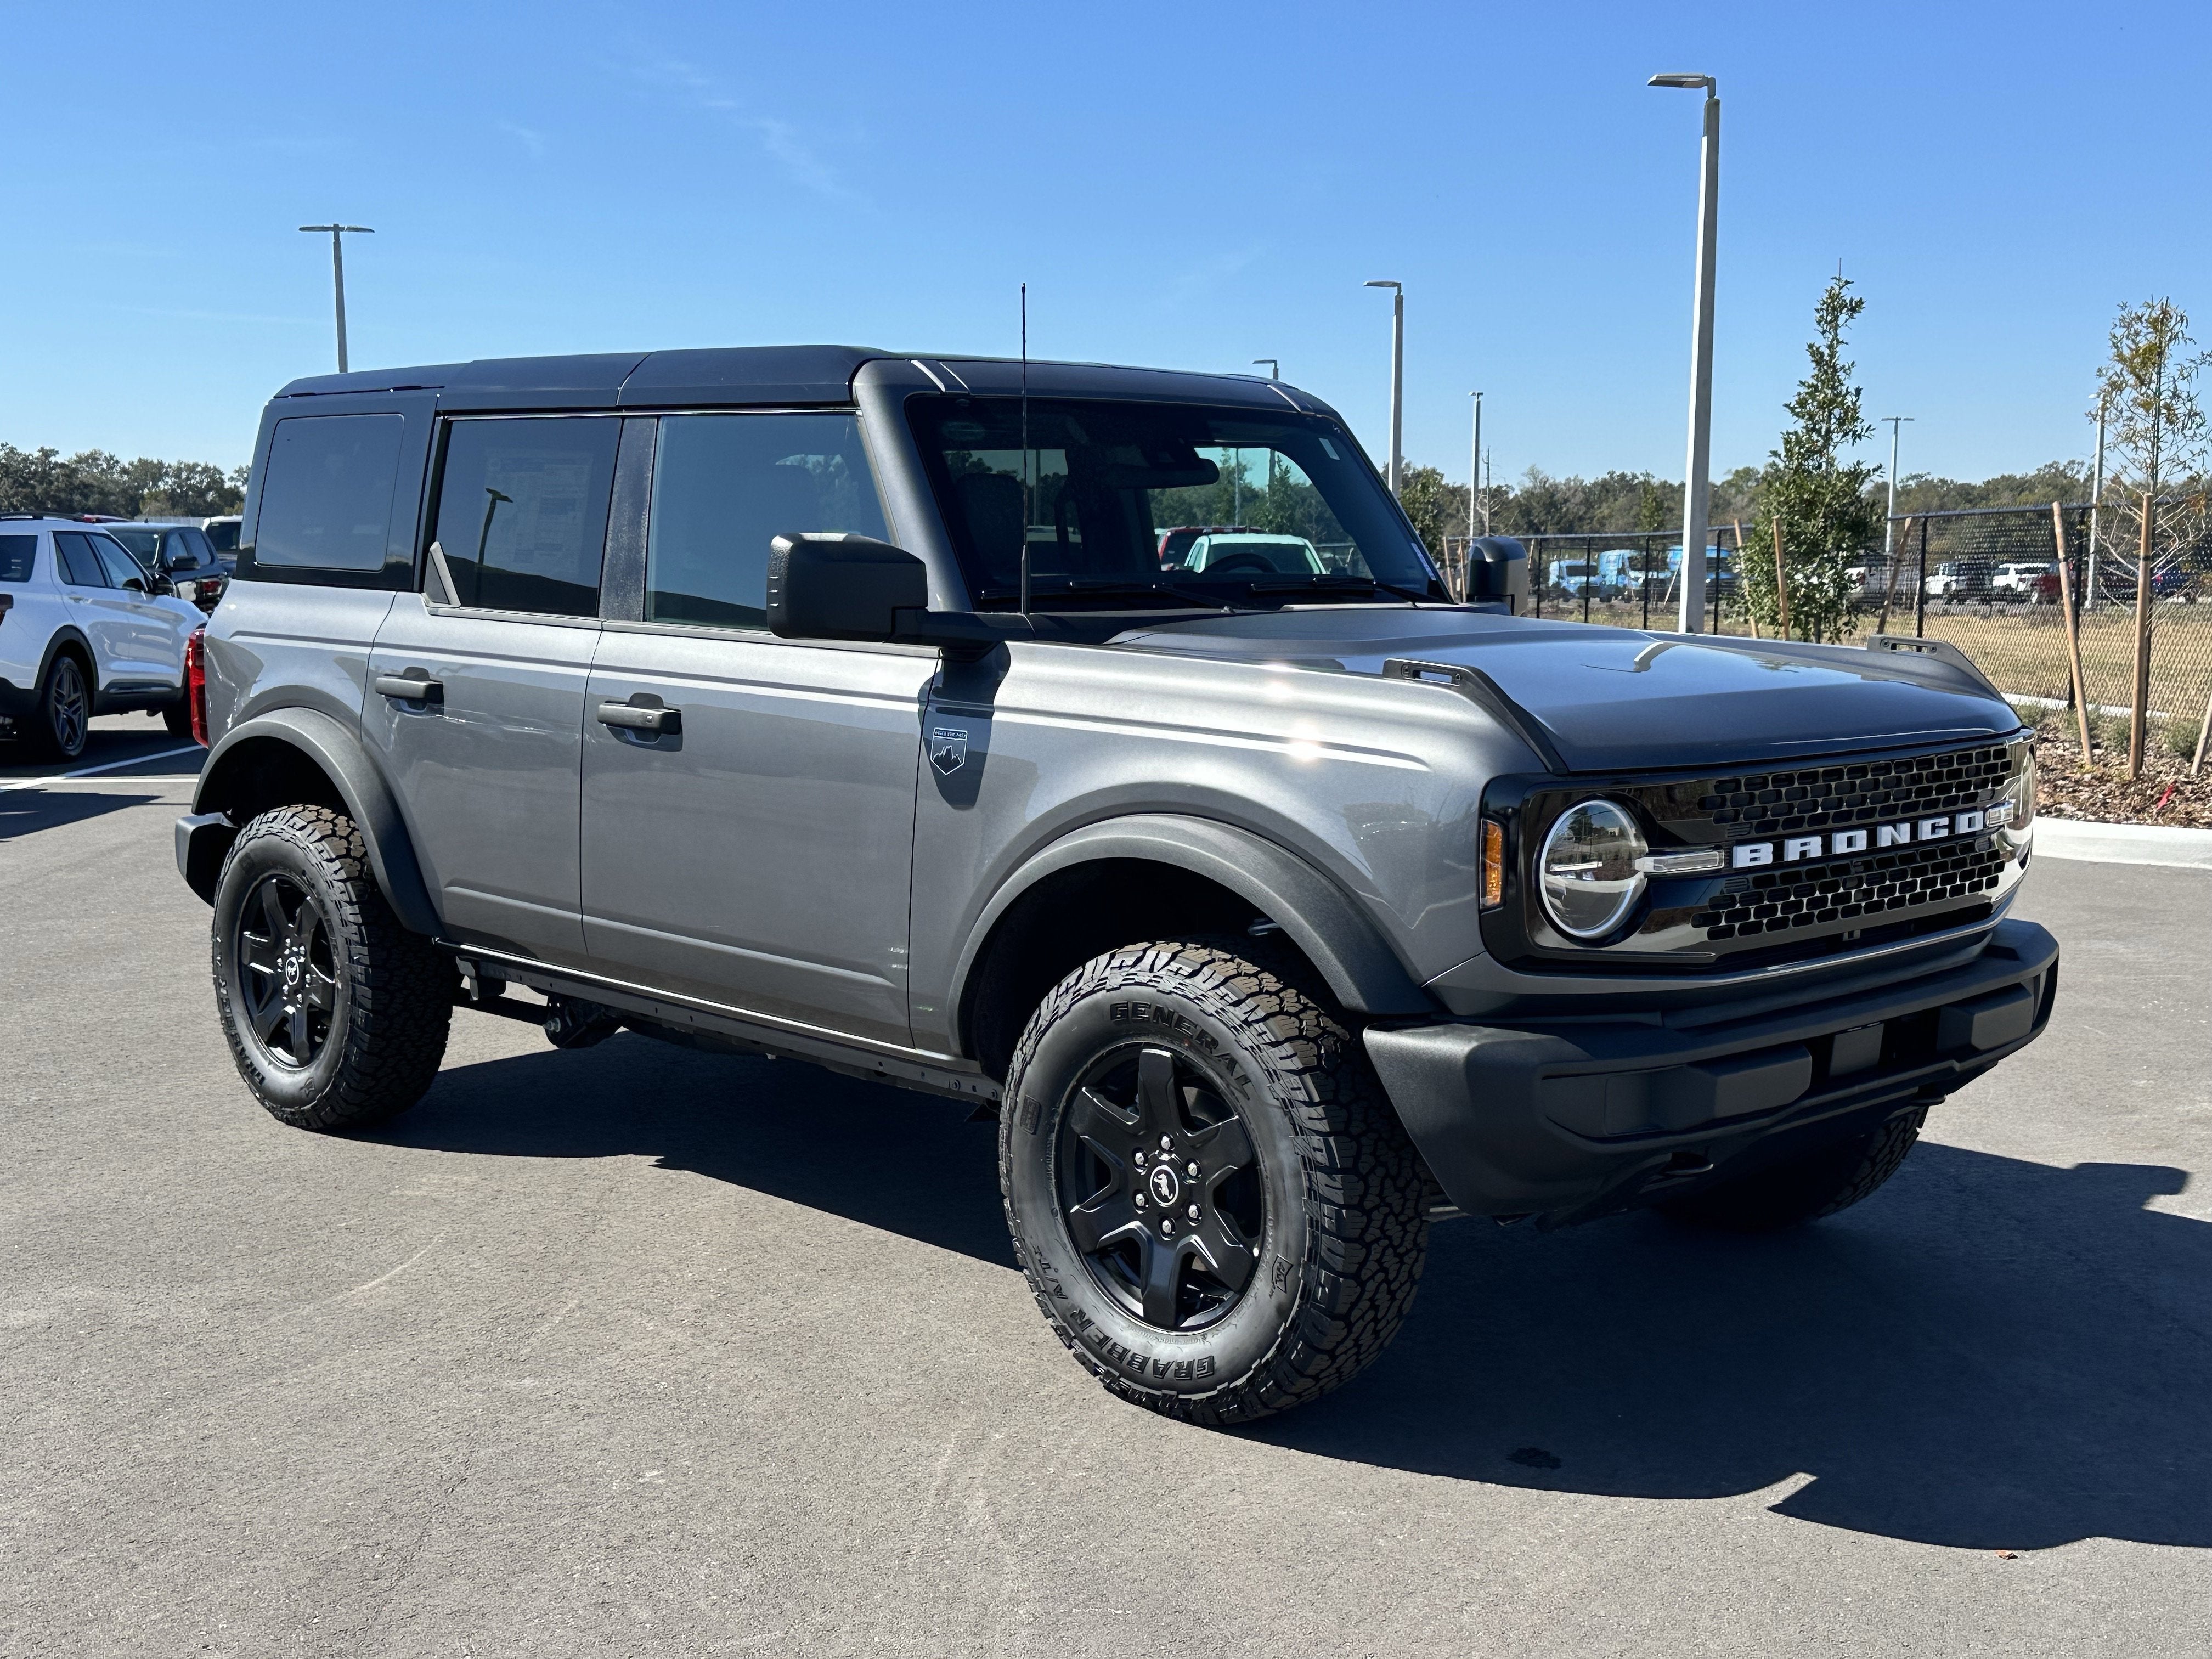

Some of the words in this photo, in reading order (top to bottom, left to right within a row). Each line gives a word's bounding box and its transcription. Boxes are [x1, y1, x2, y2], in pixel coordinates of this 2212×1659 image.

[1732, 811, 1984, 868] BRONCO
[1110, 1000, 1251, 1101] GENERAL
[1070, 1307, 1215, 1381] GRABBER
